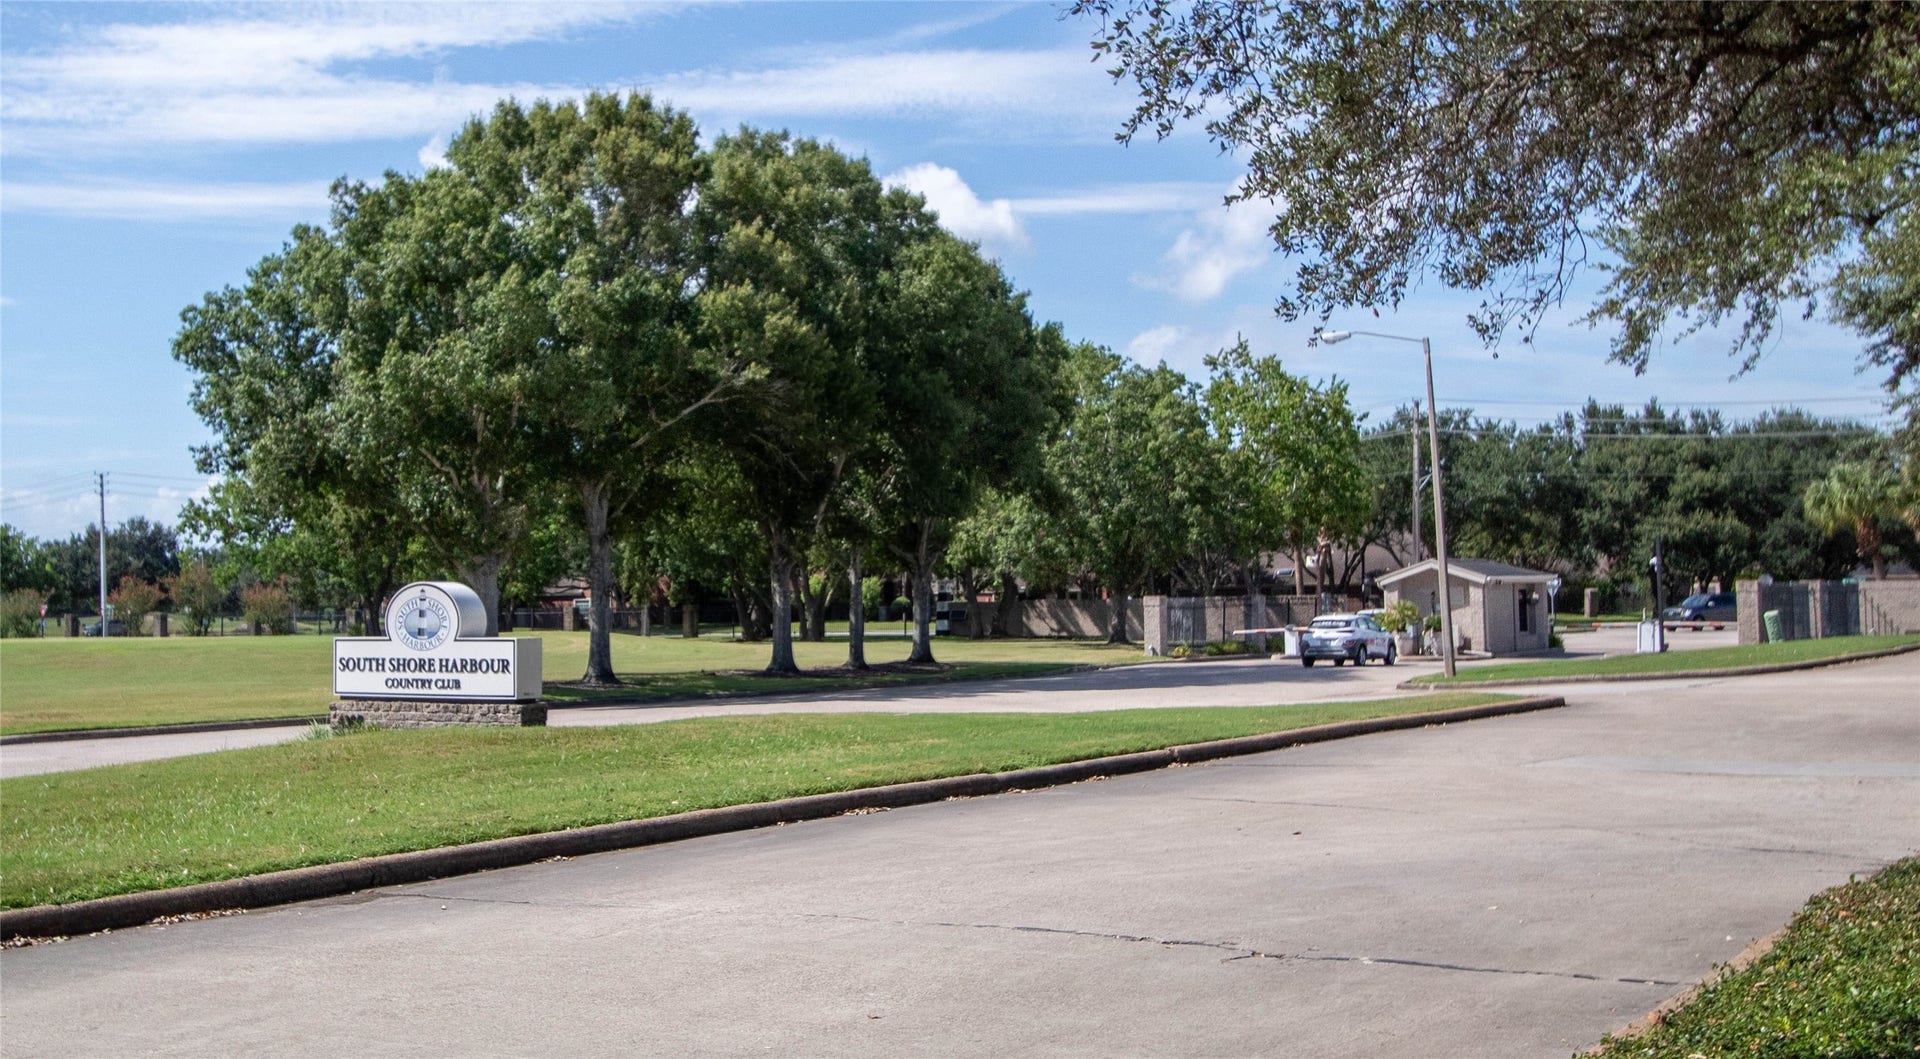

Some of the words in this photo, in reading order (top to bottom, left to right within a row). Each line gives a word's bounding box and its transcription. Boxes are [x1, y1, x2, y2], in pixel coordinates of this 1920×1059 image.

[398, 599, 418, 630] SOUTH
[402, 636, 443, 650] HARBOUR
[338, 657, 385, 673] SOUTH
[388, 658, 435, 673] SHORE
[439, 658, 511, 674] HARBOUR
[385, 677, 433, 690] COUNTRY
[435, 678, 461, 690] CLUB
